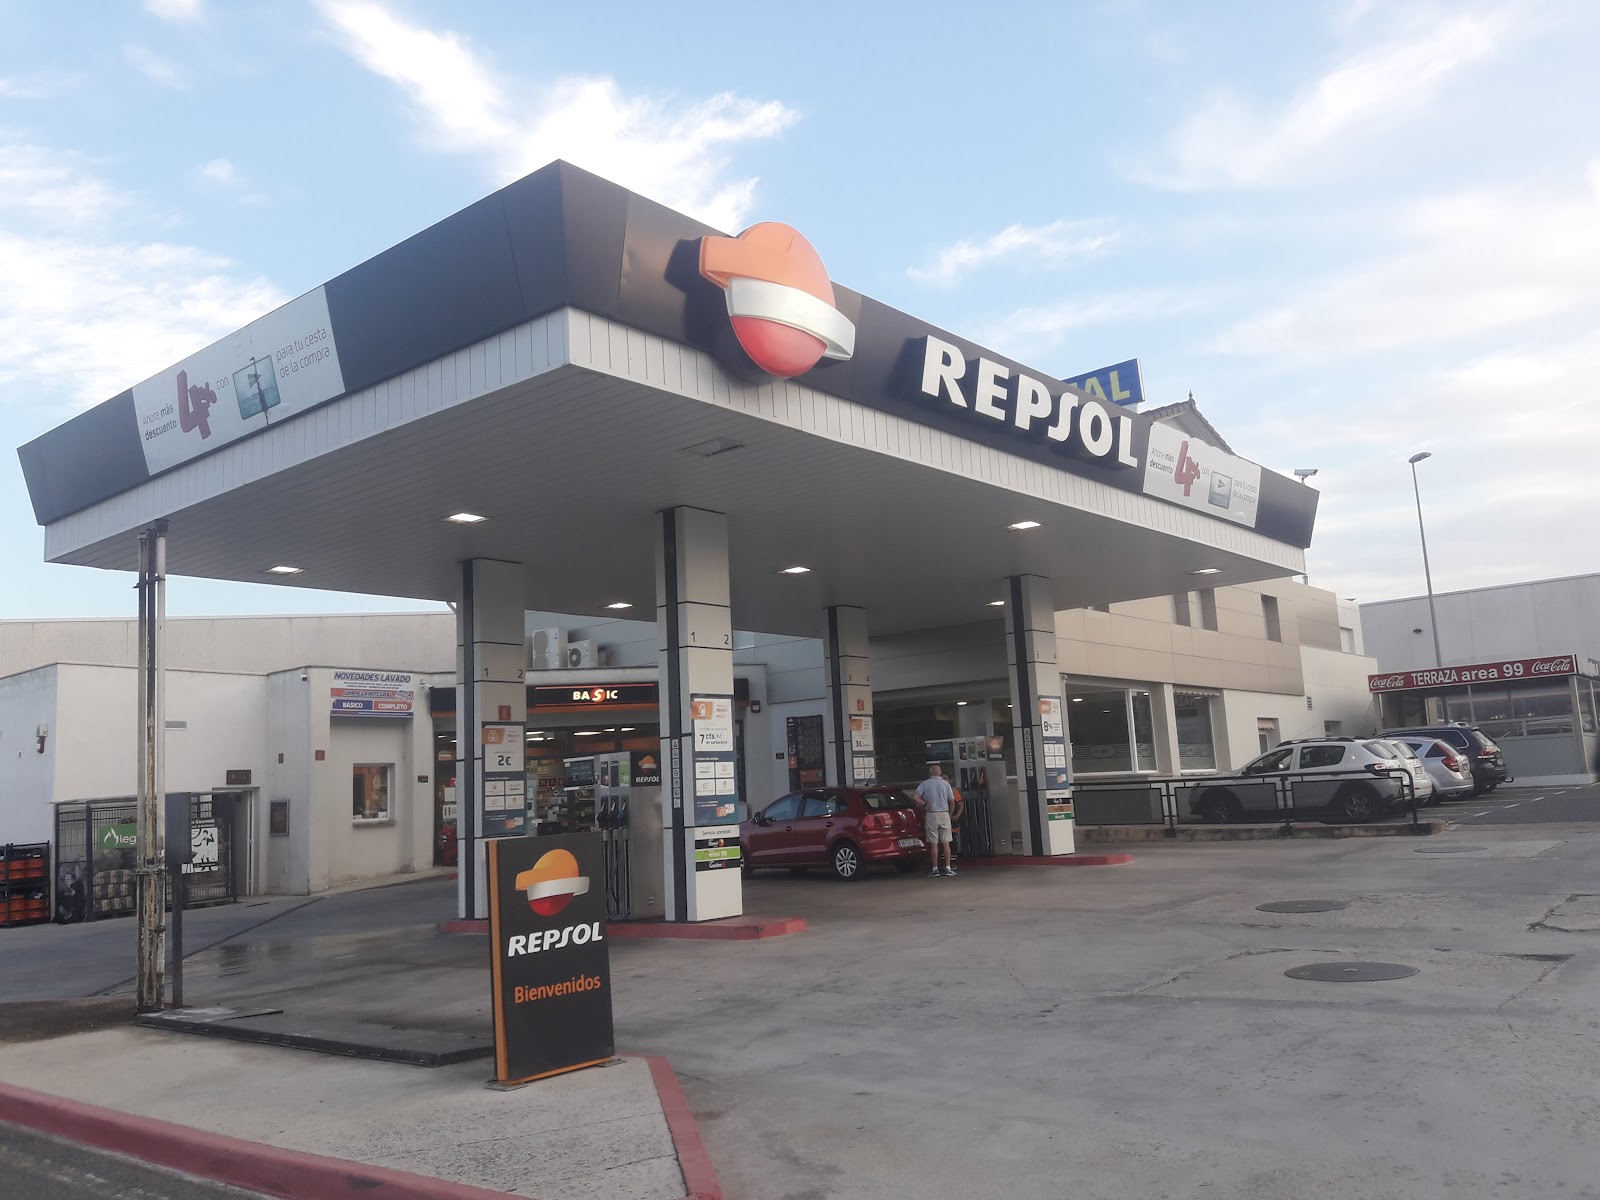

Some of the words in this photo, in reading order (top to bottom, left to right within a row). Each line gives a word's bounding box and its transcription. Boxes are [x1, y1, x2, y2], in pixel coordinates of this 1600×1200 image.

[276, 344, 294, 363] para
[294, 337, 304, 352] tu
[304, 328, 327, 348] cesta
[279, 363, 290, 378] de
[290, 360, 299, 373] la
[299, 346, 331, 370] compra
[216, 376, 229, 390] con
[1069, 370, 1131, 402] AL
[921, 334, 1138, 468] REPSOL
[142, 411, 160, 426] Ahora
[160, 403, 174, 418] más
[144, 419, 177, 441] descuento
[1164, 453, 1175, 463] más
[1149, 459, 1174, 475] descuento
[690, 631, 696, 643] 1
[723, 634, 730, 645] 2
[334, 671, 379, 682] NOVEDADES
[380, 674, 411, 684] LAVADO
[517, 668, 524, 679] 2
[1370, 674, 1405, 689] Coca-Cola
[1411, 669, 1459, 686] TERRAZA
[1461, 668, 1499, 681] area
[1502, 662, 1524, 677] 99
[1531, 658, 1572, 674] Coca-Cola
[573, 688, 618, 702] BASIC
[342, 701, 363, 709] BÁSICO
[699, 733, 705, 745] 7
[497, 754, 512, 766] 2€
[508, 921, 604, 958] REPSOL
[514, 974, 602, 1005] Bienvenidos
